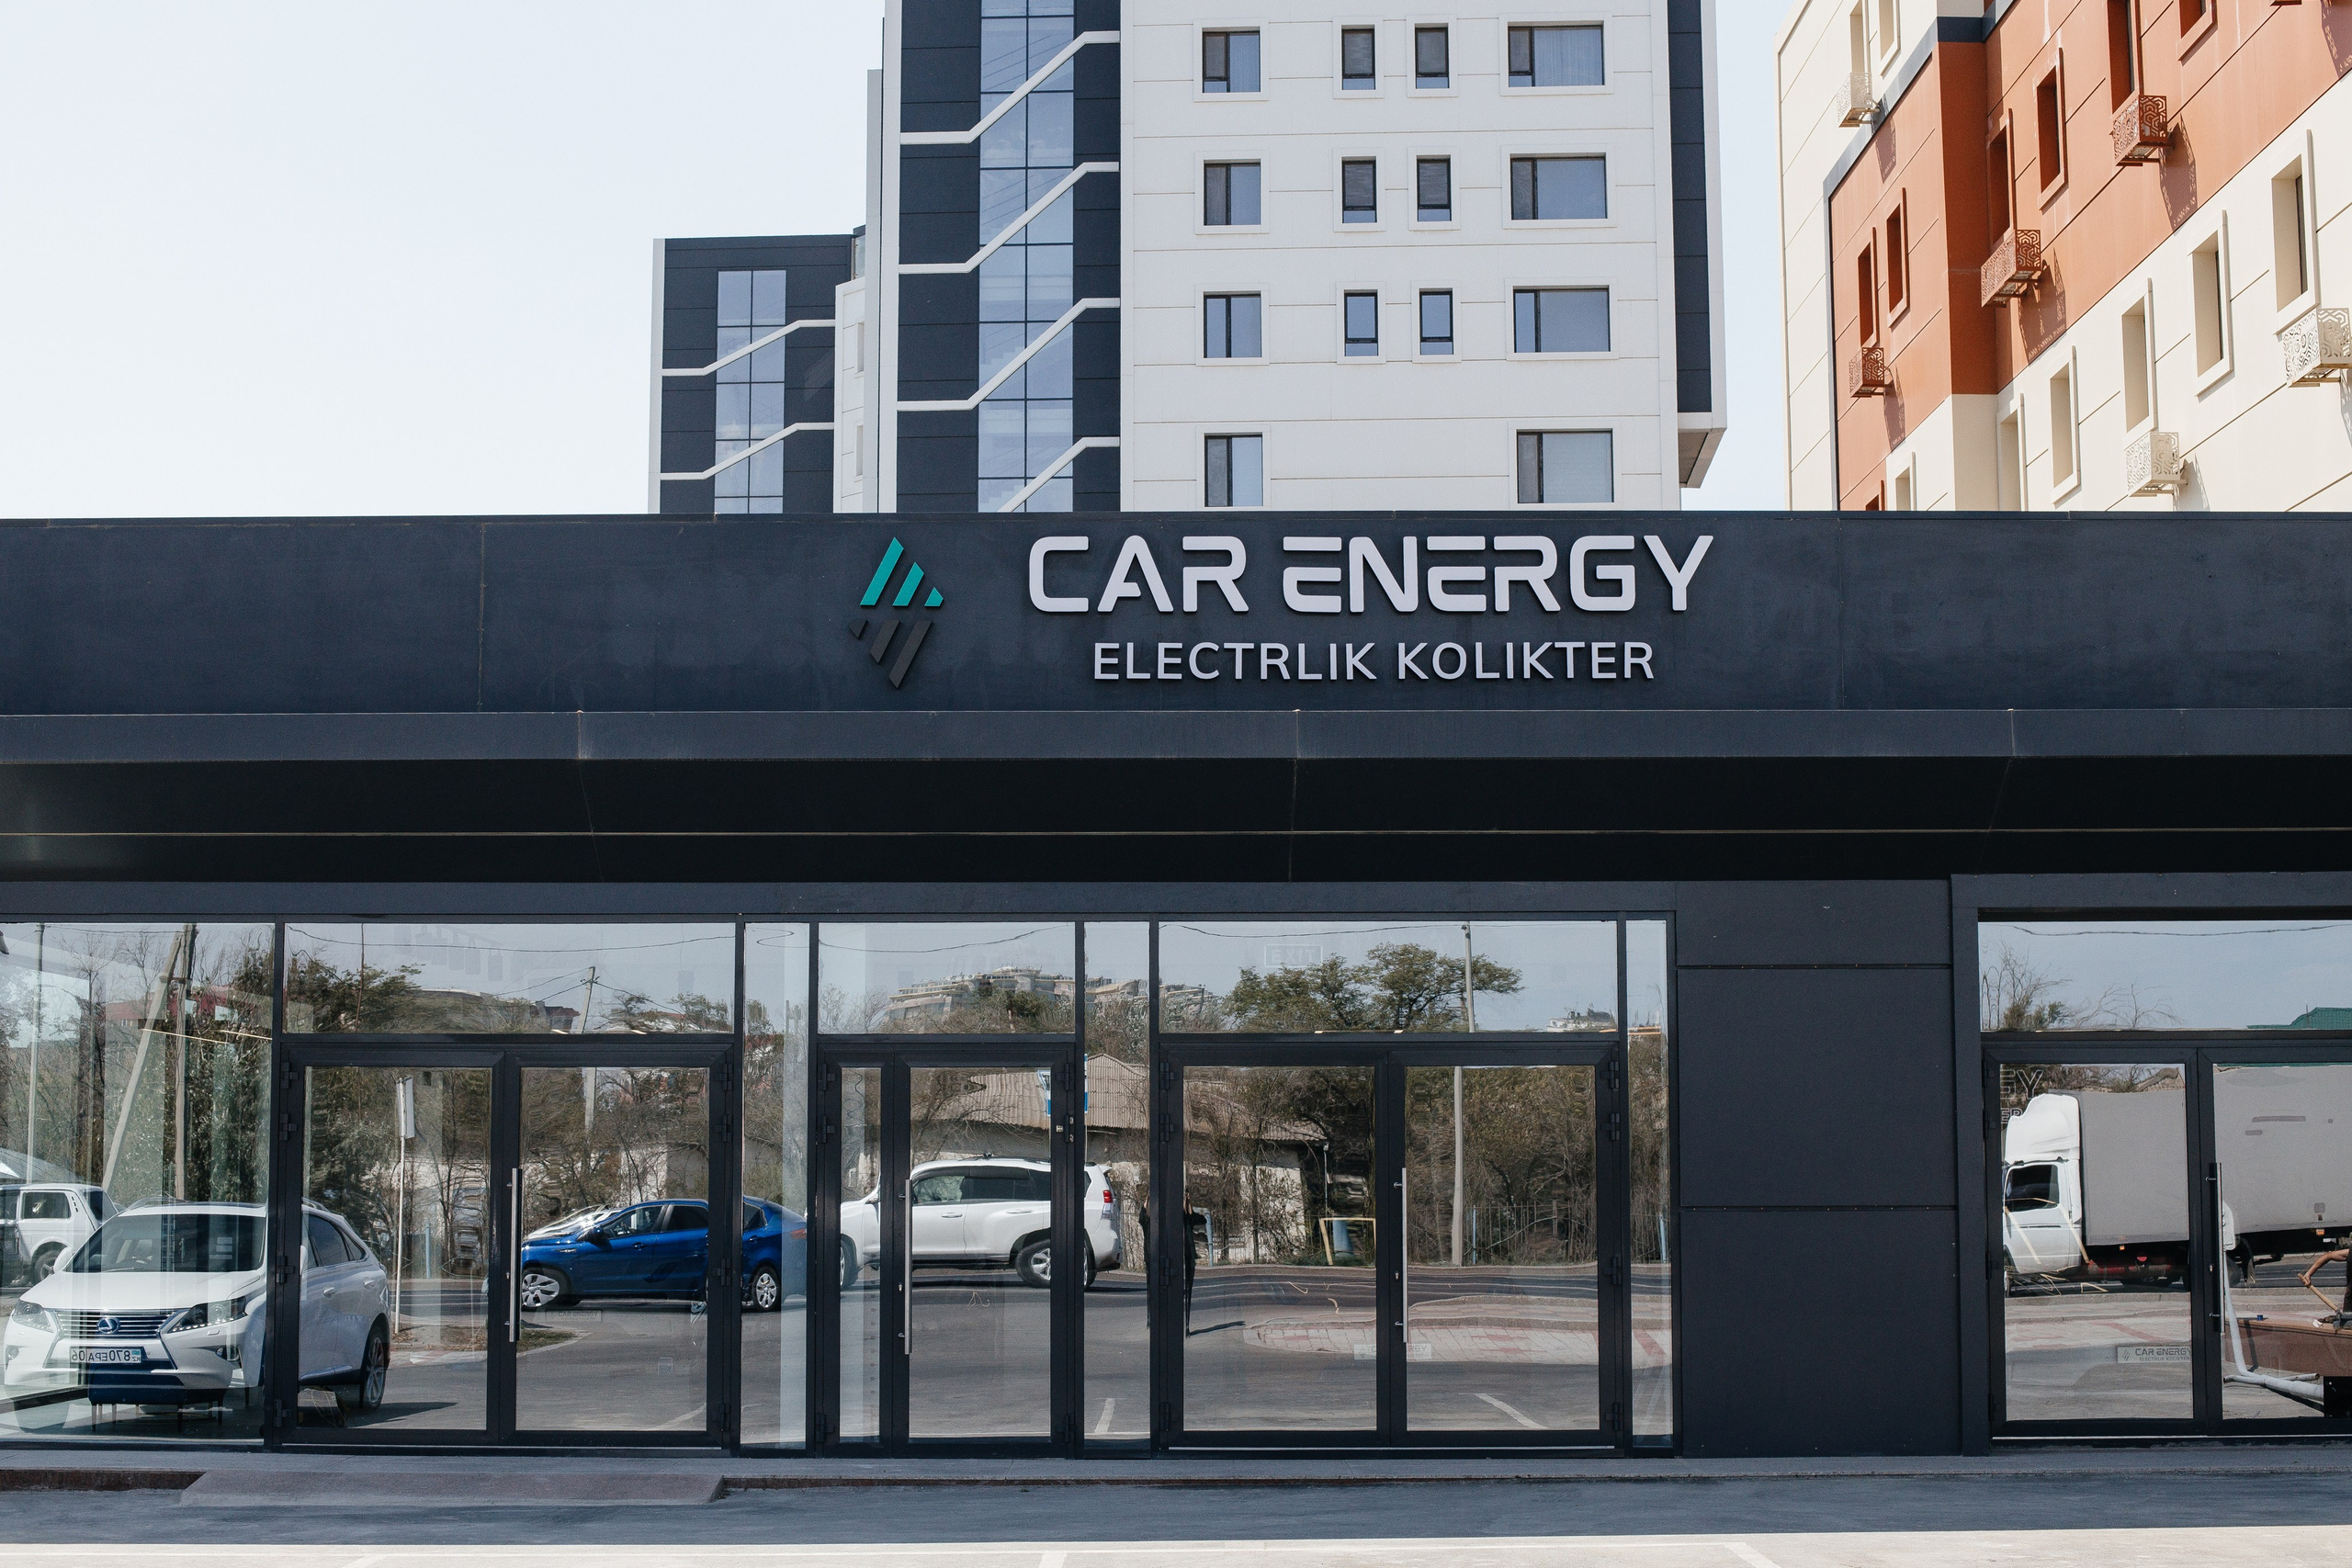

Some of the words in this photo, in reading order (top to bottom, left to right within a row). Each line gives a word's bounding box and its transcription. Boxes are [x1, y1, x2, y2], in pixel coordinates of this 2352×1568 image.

[1028, 534, 1250, 613] CAR
[1283, 534, 1714, 613] ENERGY
[1093, 641, 1378, 681] ELECTRLIK
[1397, 641, 1655, 681] KOLIKTER
[1271, 948, 1316, 964] EXIT
[2135, 1348, 2154, 1356] CAR
